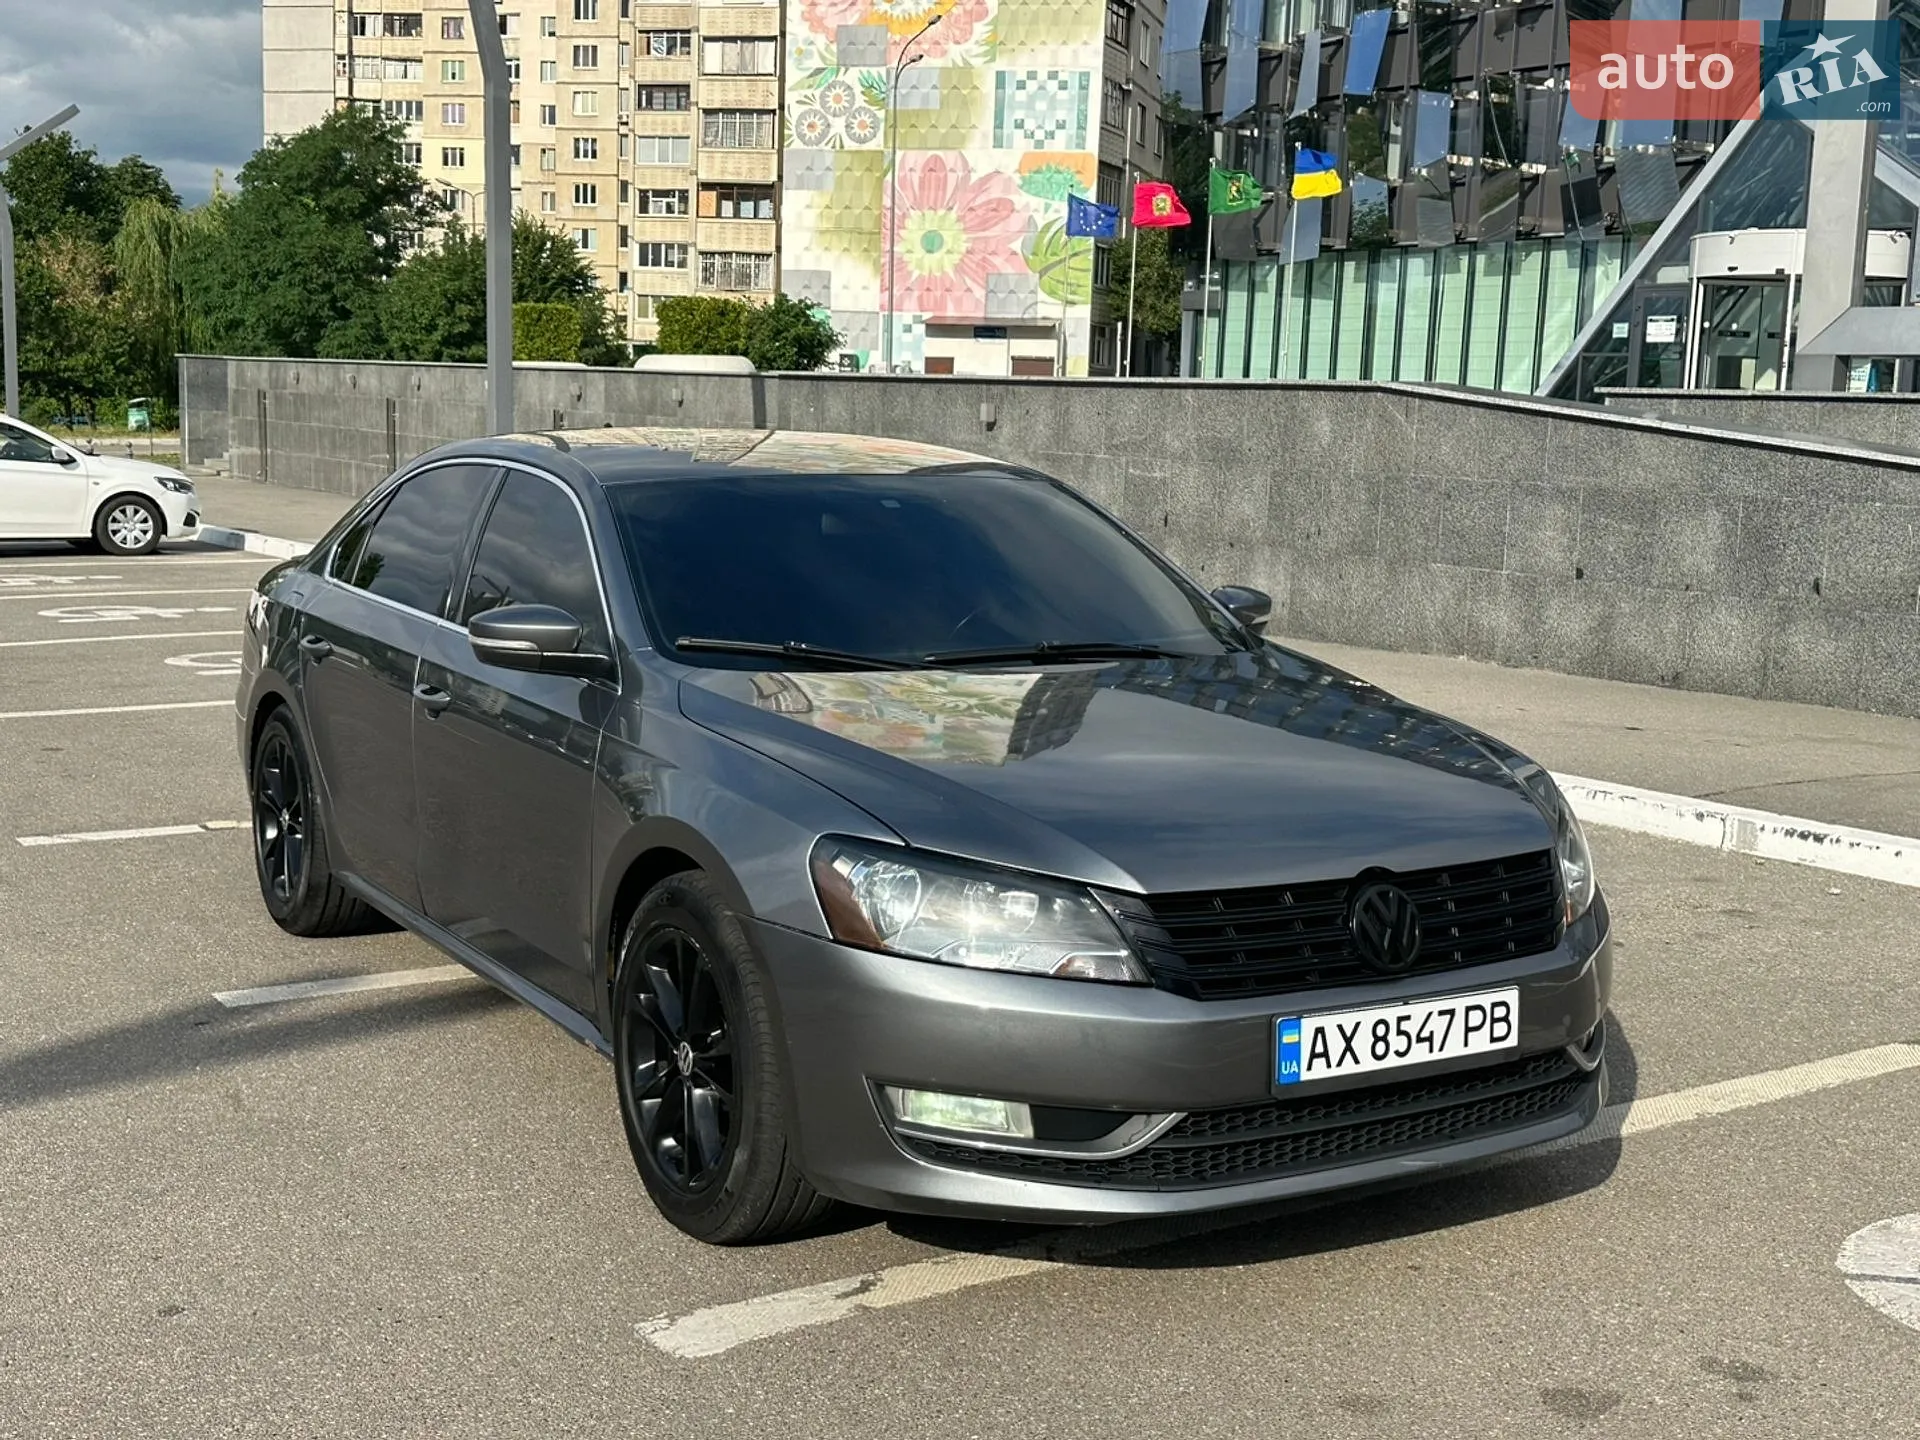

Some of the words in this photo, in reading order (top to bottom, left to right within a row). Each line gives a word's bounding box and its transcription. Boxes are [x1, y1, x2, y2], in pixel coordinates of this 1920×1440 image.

[1306, 1021, 1361, 1072] AX
[1370, 1008, 1456, 1062] 8547
[1463, 1000, 1512, 1048] PB
[1281, 1062, 1299, 1075] UA
